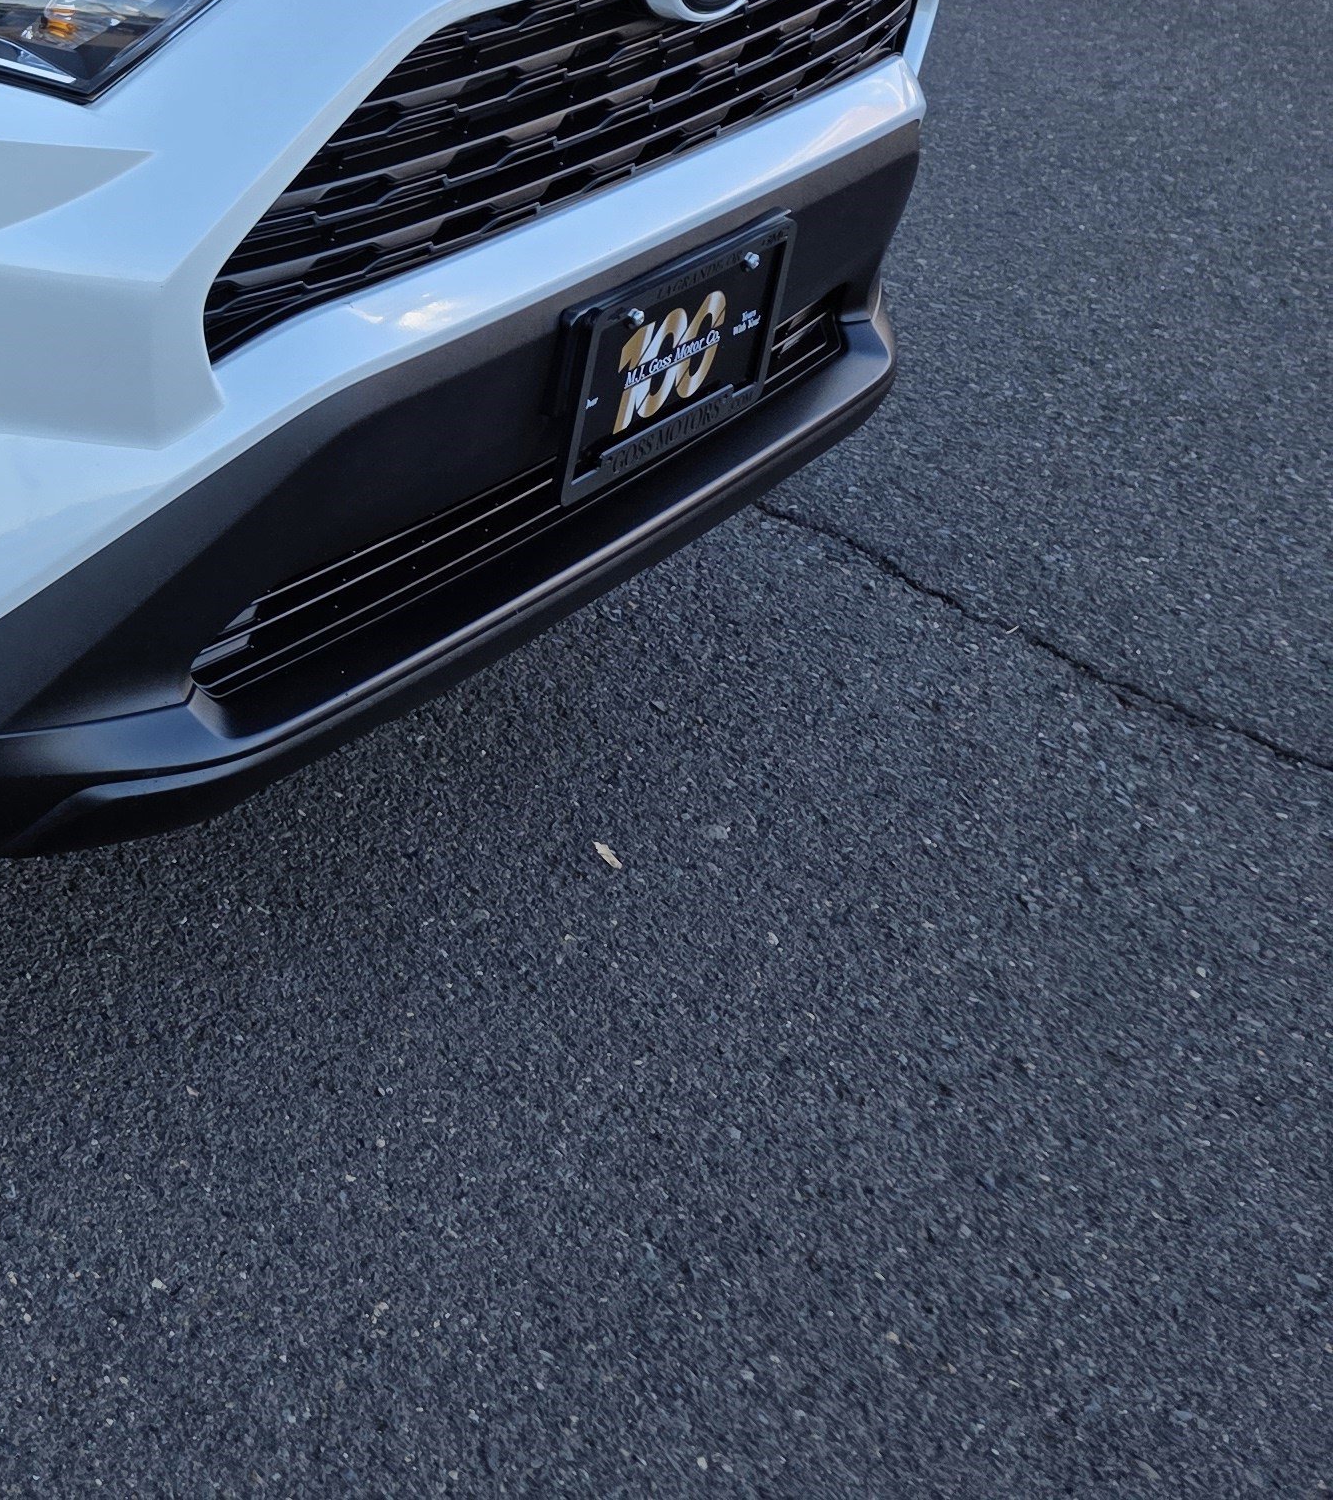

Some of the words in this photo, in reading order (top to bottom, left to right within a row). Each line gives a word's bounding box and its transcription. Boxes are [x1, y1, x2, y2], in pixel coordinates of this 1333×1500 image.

[613, 291, 727, 435] 100
[624, 366, 647, 389] M.J.
[649, 353, 673, 375] Goss
[674, 337, 704, 363] Motor
[705, 328, 721, 347] Co.
